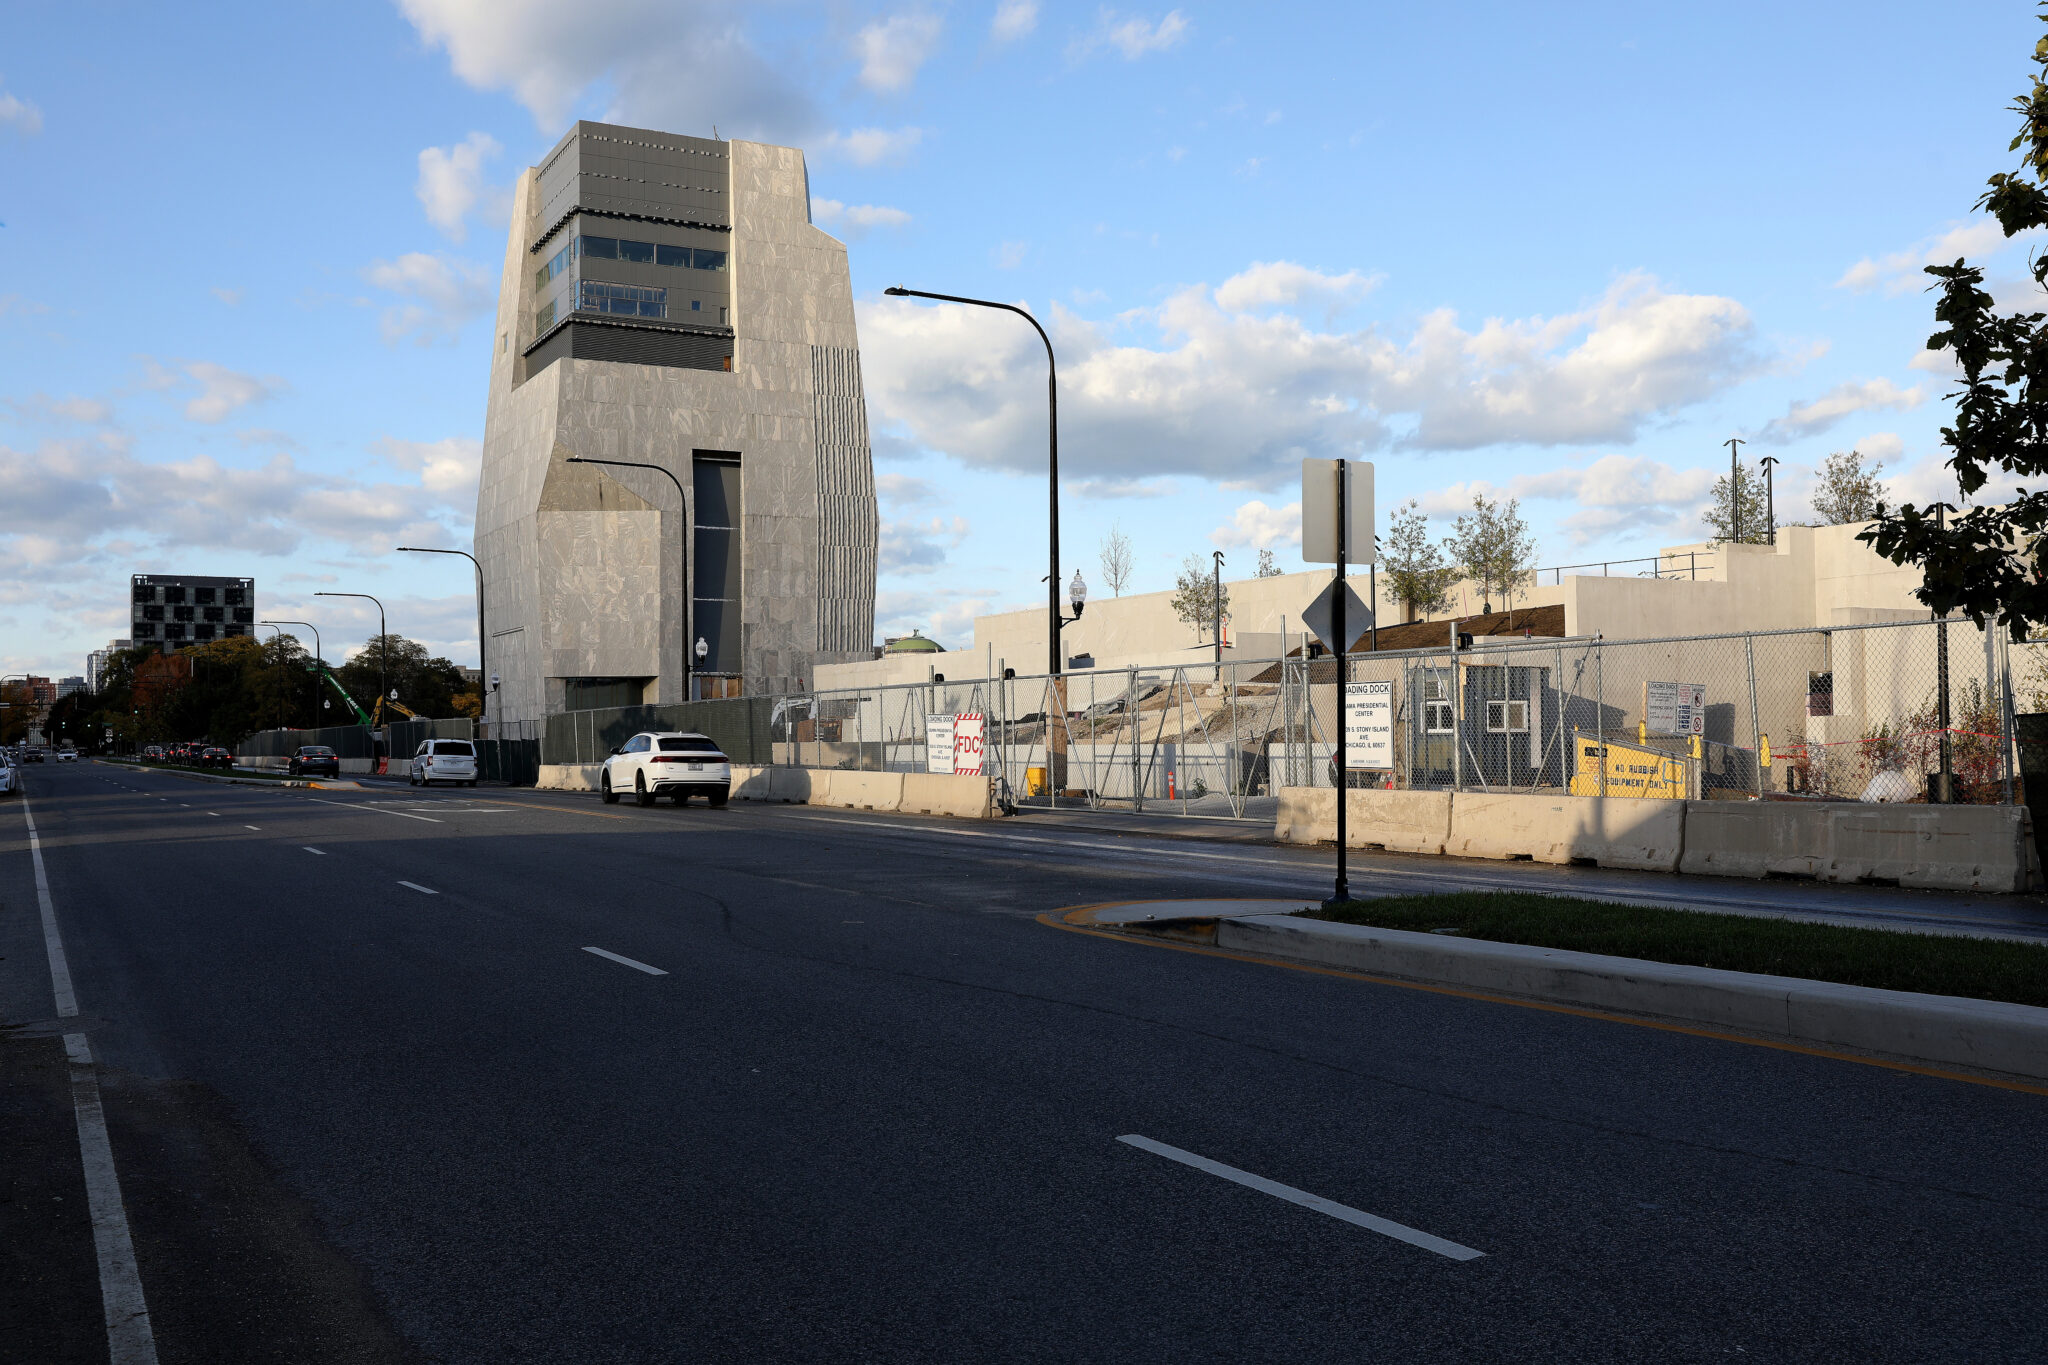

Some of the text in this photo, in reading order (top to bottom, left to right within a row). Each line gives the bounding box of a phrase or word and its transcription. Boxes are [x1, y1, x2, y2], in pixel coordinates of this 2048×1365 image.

[1346, 684, 1389, 694] ADING DOCK
[958, 736, 979, 753] FDC
[1616, 764, 1624, 772] NO
[1629, 765, 1658, 774] RUBBISH
[1607, 777, 1667, 789] EQUIPMENT ONLY
